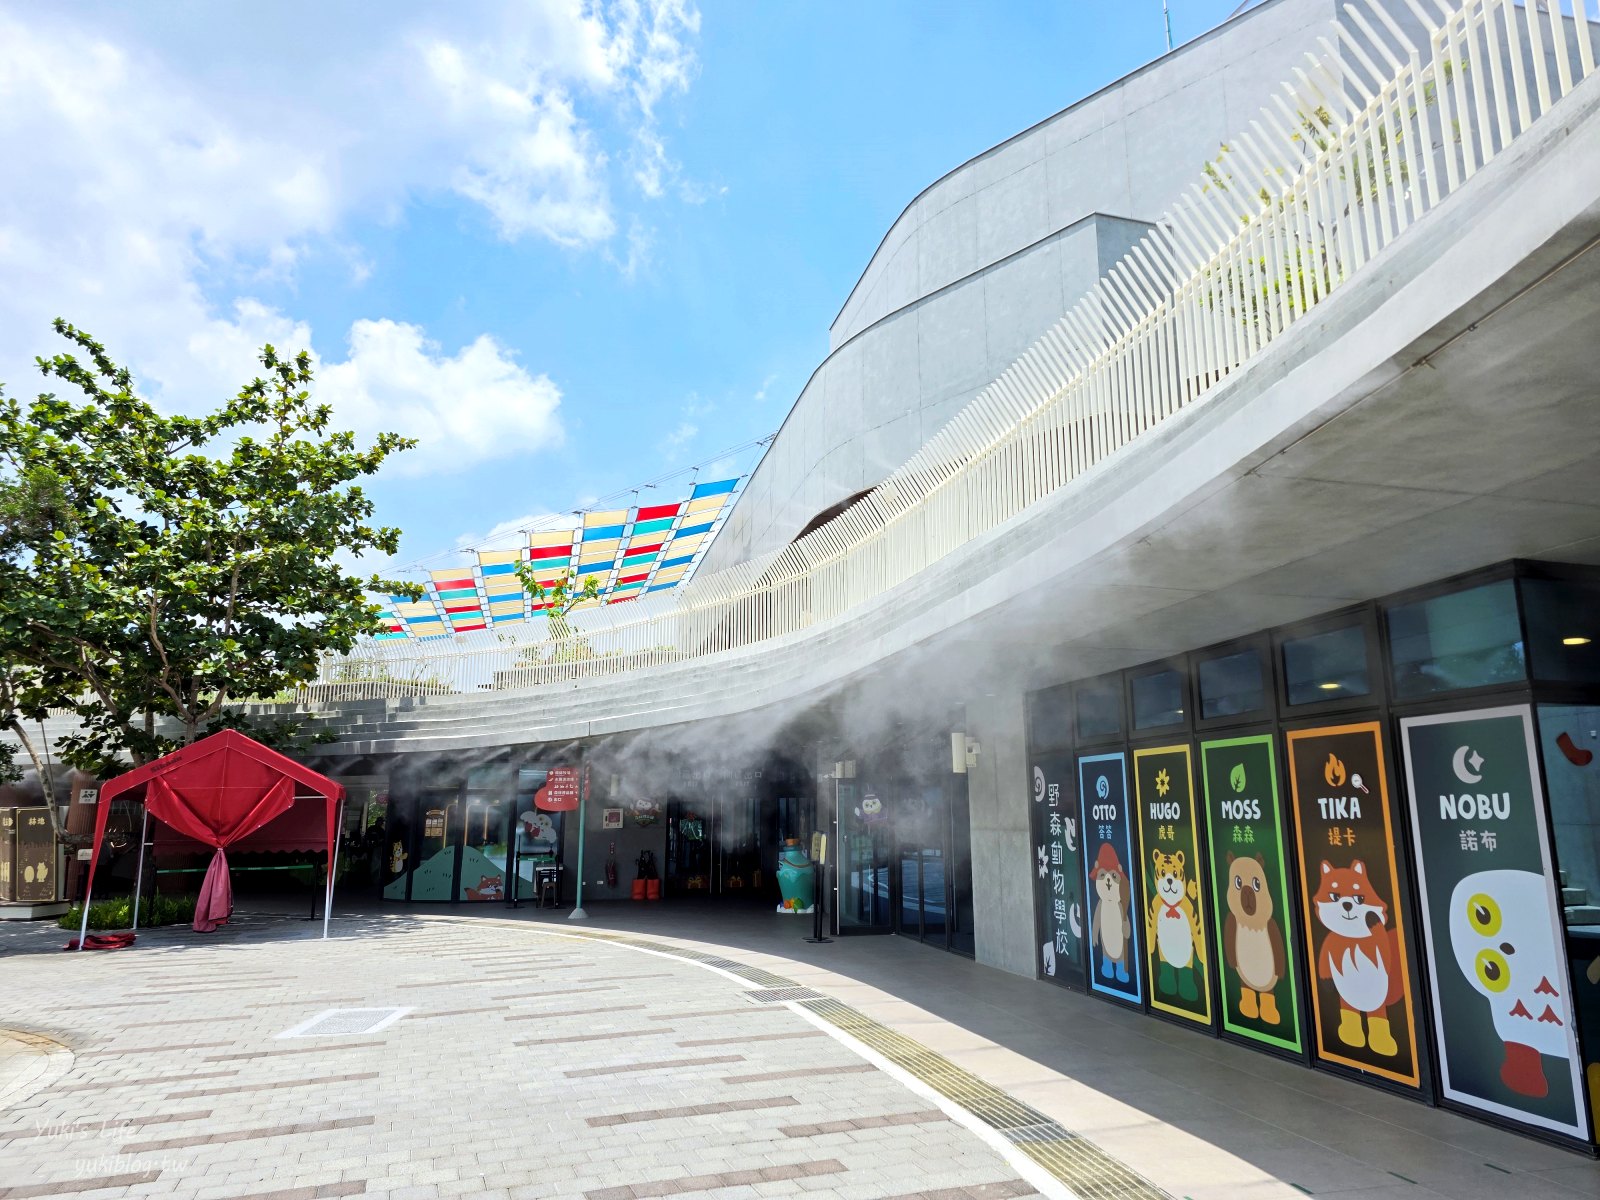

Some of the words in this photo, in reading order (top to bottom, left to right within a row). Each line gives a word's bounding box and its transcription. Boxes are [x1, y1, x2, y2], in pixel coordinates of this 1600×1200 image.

[1092, 804, 1117, 821] OTTO
[1150, 802, 1181, 820] HUGO
[1221, 799, 1262, 820] MOSS
[1317, 796, 1362, 820] TIKA
[1439, 792, 1511, 821] NOBU
[1098, 825, 1113, 840] 答答
[1158, 825, 1175, 841] 虎哥
[1232, 825, 1255, 844] 森森
[1328, 826, 1356, 847] 提卡
[1459, 829, 1498, 852] 諾布
[1047, 782, 1070, 956] 野森動物學校
